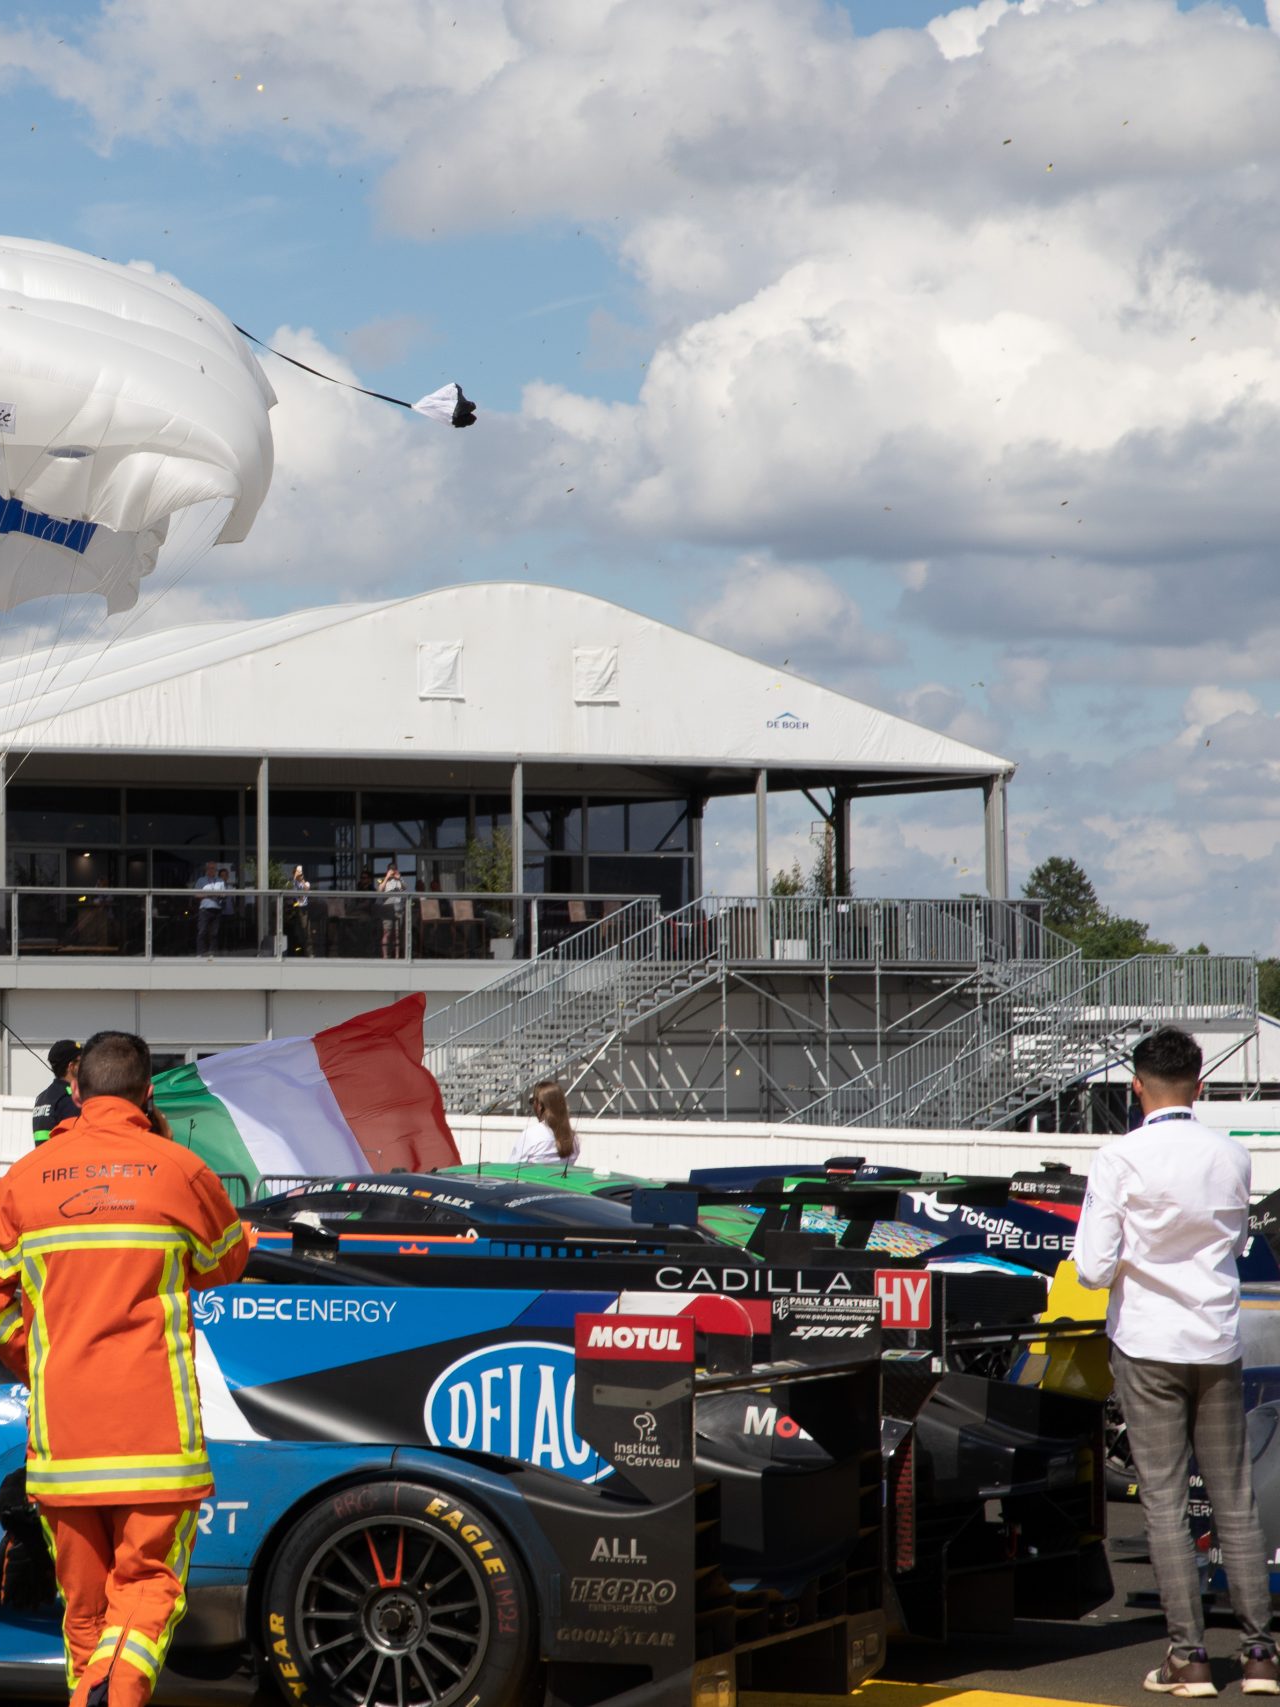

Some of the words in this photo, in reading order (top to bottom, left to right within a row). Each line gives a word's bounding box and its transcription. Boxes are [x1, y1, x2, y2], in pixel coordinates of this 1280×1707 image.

[767, 720, 780, 729] DE
[42, 1166, 79, 1184] FIRE
[86, 1164, 158, 1178] SAFETY
[307, 1183, 333, 1195] IAN
[356, 1182, 410, 1196] DANIEL
[432, 1193, 475, 1210] ALEX
[655, 1267, 853, 1293] CADILLA
[297, 1300, 397, 1323] ENERGY
[789, 1297, 821, 1306] PAULY
[823, 1298, 831, 1306] &
[833, 1298, 880, 1308] PARTNER
[587, 1325, 683, 1351] MOTUL
[789, 1323, 873, 1340] spark
[614, 1441, 661, 1456] Institut
[626, 1454, 680, 1469] Cerveau
[423, 1497, 507, 1576] EAGLE
[589, 1537, 647, 1562] ALL
[570, 1576, 677, 1606] TECPRO
